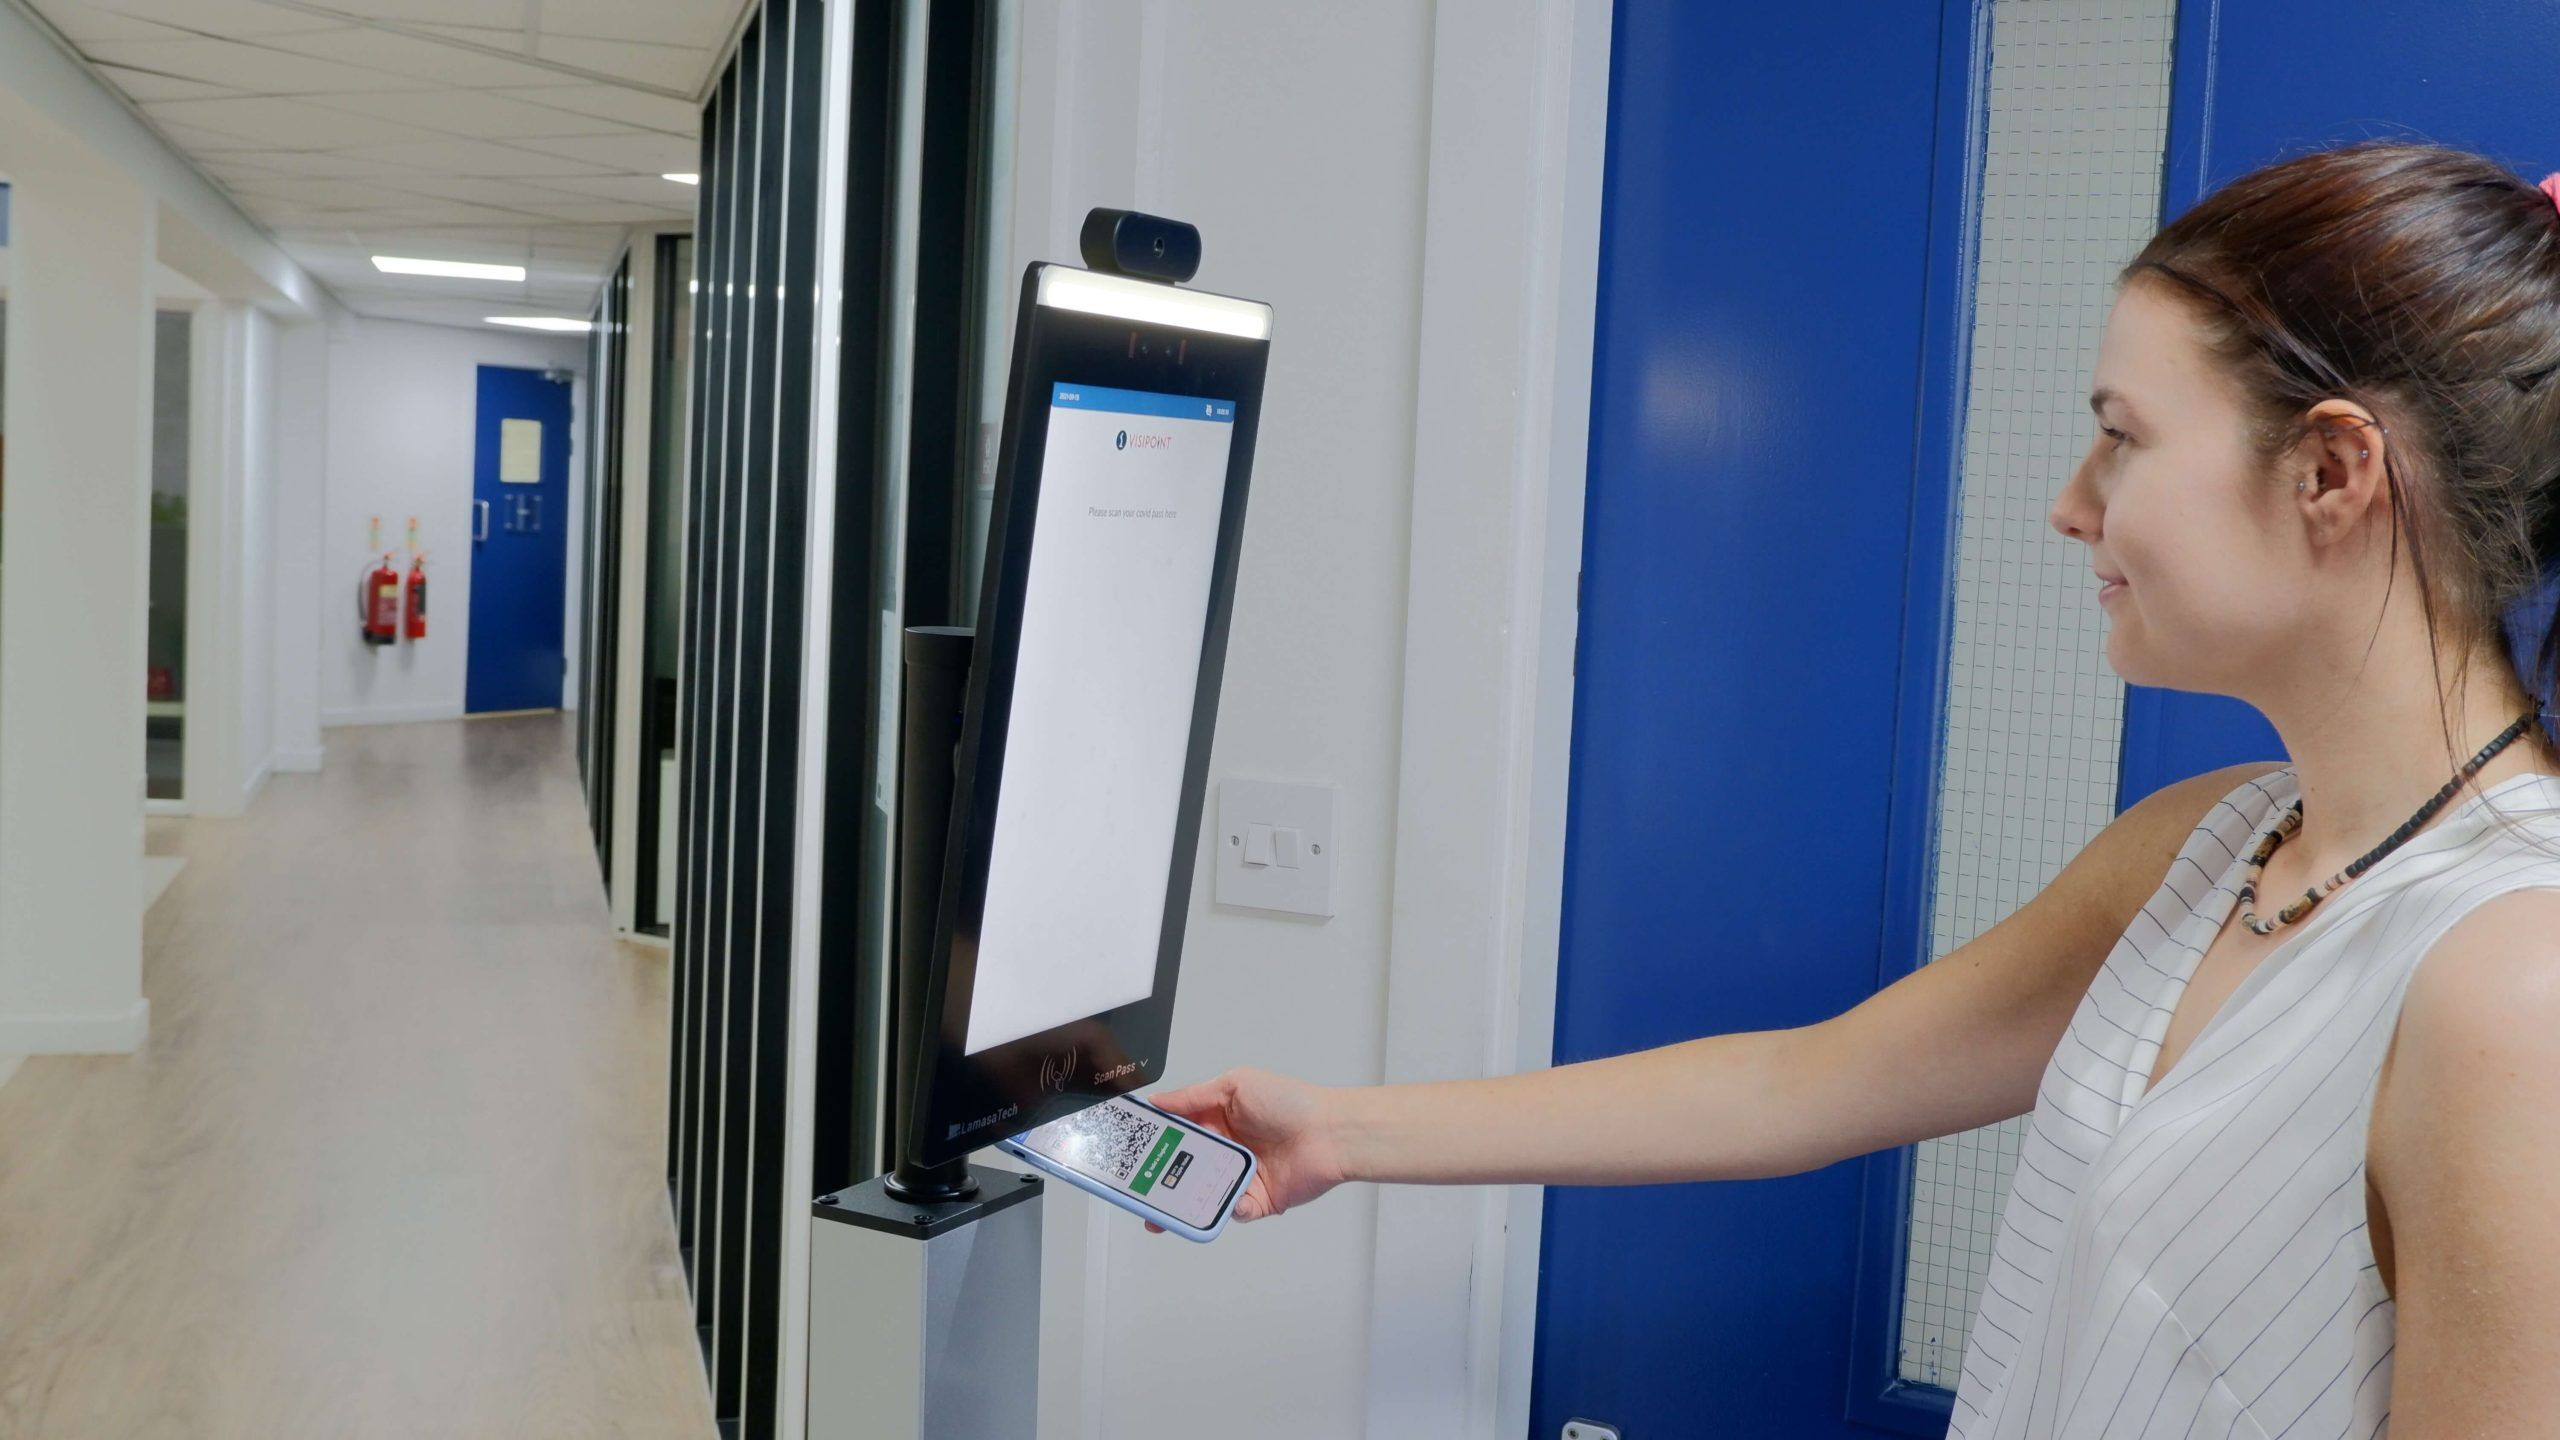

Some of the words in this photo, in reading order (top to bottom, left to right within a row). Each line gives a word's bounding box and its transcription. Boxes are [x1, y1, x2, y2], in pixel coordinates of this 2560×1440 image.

[1088, 506, 1107, 517] Please
[1108, 508, 1121, 518] scan
[1122, 509, 1135, 519] your
[1094, 1070, 1115, 1086] Scan
[1115, 1062, 1136, 1078] Pass
